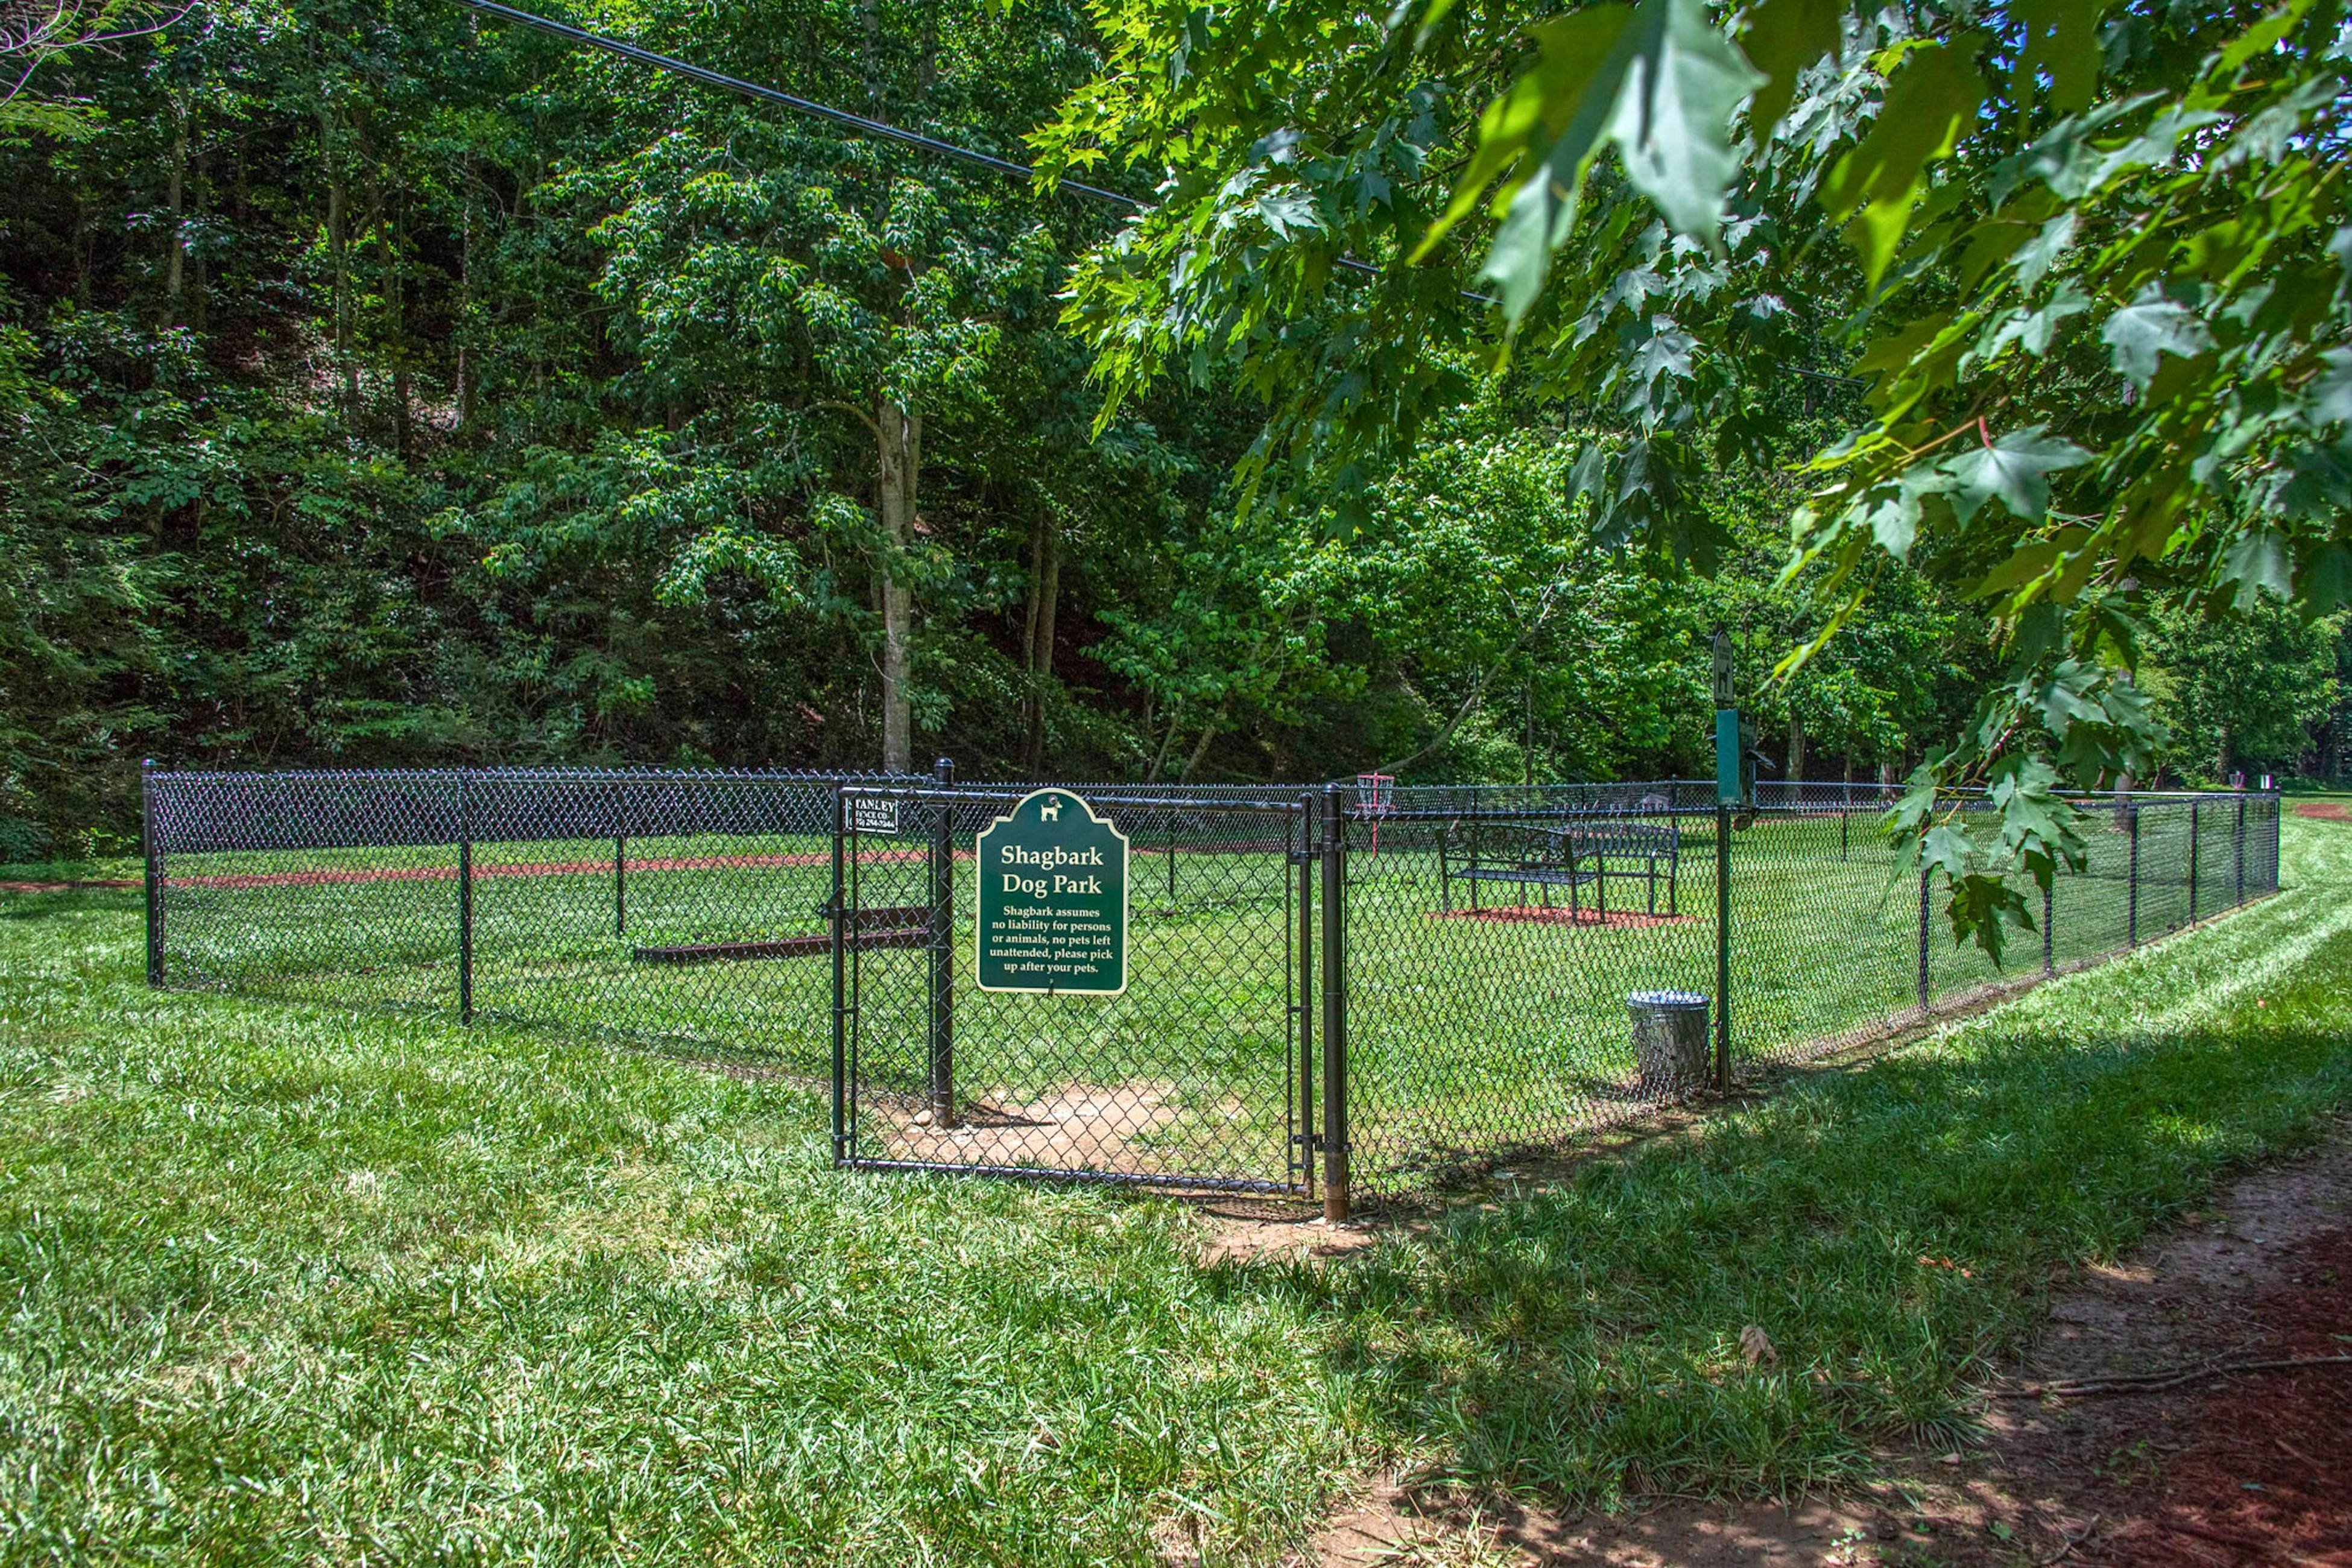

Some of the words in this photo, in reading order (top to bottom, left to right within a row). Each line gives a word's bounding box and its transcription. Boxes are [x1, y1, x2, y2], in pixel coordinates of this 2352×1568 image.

[1001, 845, 1104, 871] Shagbark
[1002, 874, 1048, 899] Dog
[1053, 874, 1102, 894] Park
[1003, 905, 1053, 918] Shagbark
[1055, 909, 1100, 917] assumes
[1008, 919, 1049, 933] liability
[1052, 920, 1068, 931] for
[1070, 923, 1111, 934] persons
[1005, 934, 1049, 945] animals,
[1069, 937, 1090, 947] pets
[1093, 935, 1111, 945] left
[990, 947, 1052, 959] unattended,
[1054, 948, 1087, 962] please
[1090, 949, 1113, 962] pick
[1004, 963, 1018, 973] up
[1020, 961, 1045, 972] after
[1047, 964, 1072, 975] your
[1074, 964, 1099, 975] pets.
